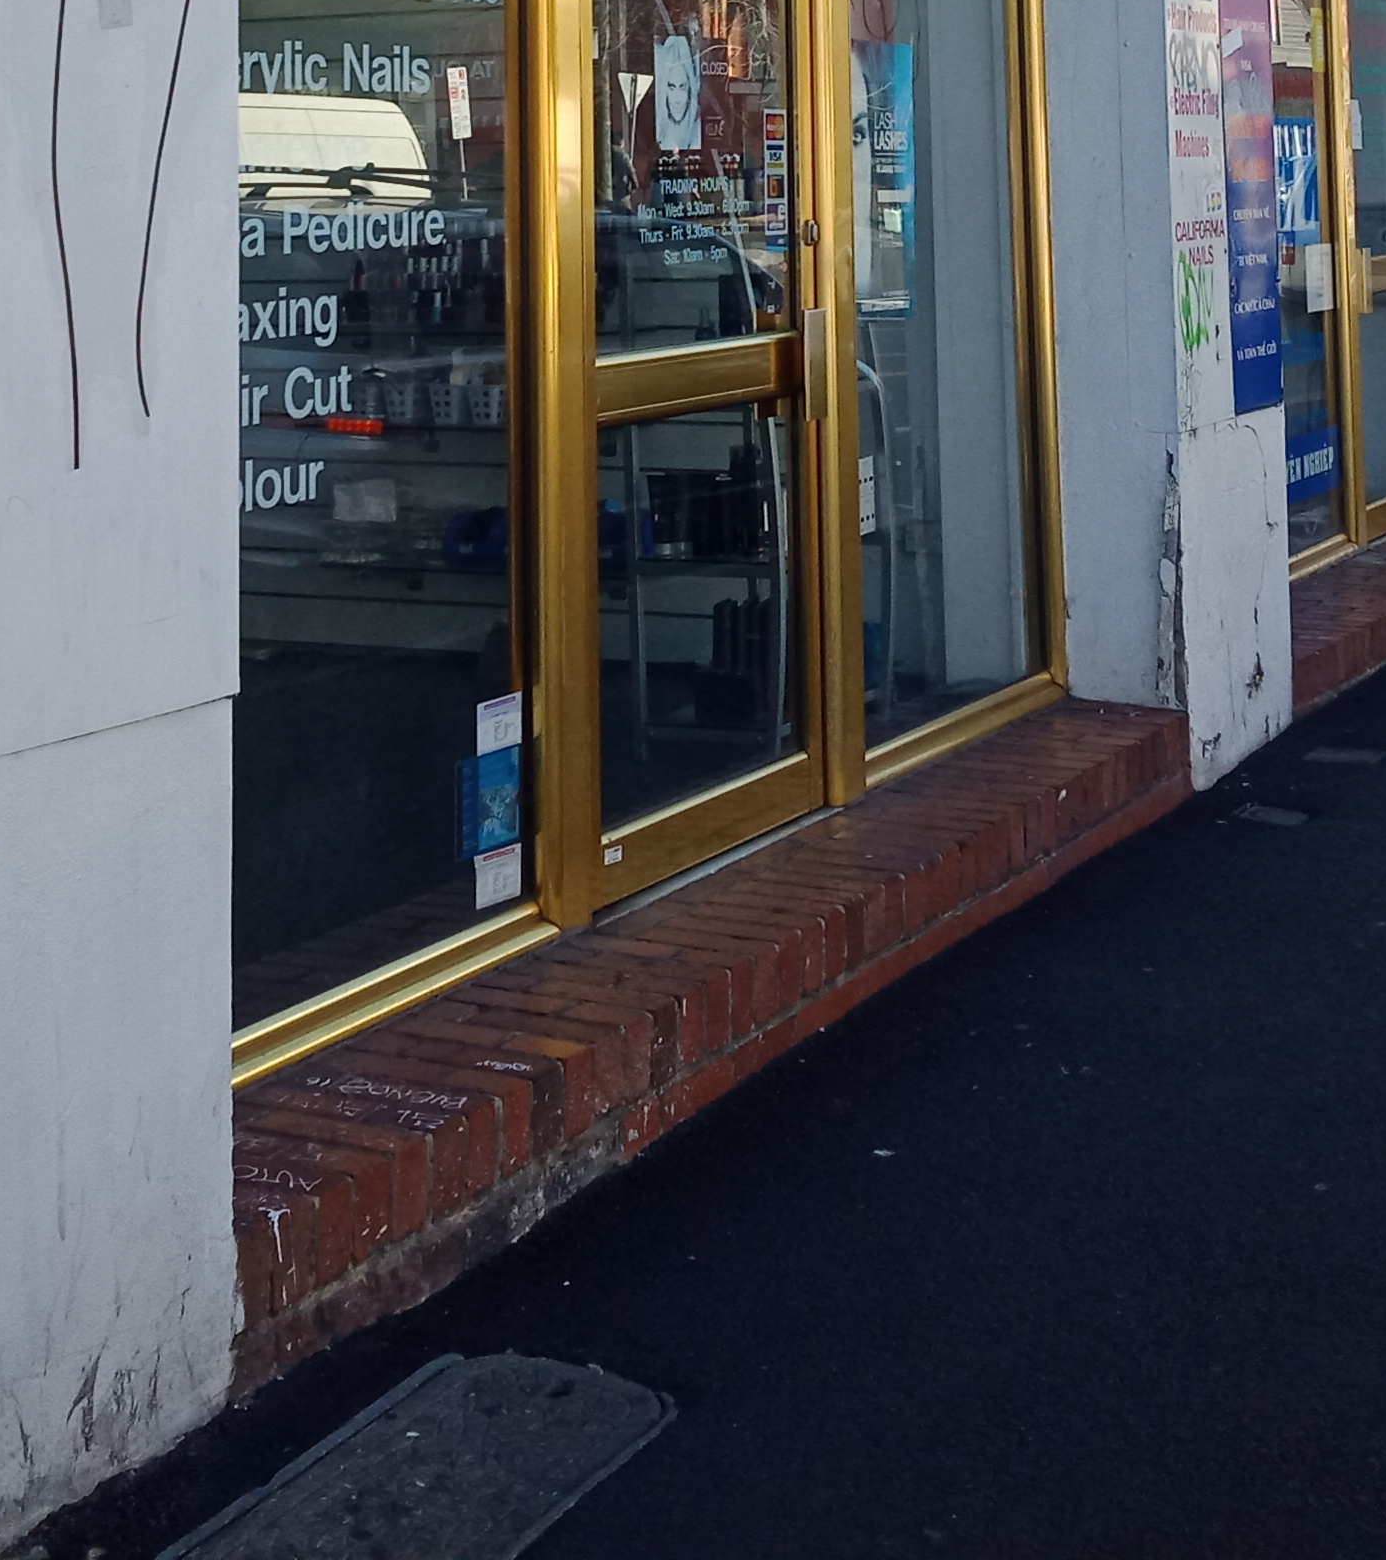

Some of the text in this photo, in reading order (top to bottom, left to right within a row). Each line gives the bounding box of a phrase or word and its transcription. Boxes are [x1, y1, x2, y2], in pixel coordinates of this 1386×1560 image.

[237, 40, 432, 95] rylic Nails
[874, 131, 908, 151] LASHES
[660, 177, 730, 195] TRADING HOURS
[637, 204, 656, 220] Mon
[664, 202, 684, 218] Wed:
[686, 200, 714, 216] 9.30am
[241, 201, 445, 258] a Pedicure
[639, 228, 663, 245] Thurs
[671, 226, 684, 241] Fri:
[686, 224, 714, 240] 9.30am
[1175, 219, 1225, 242] CALIFORNIA
[683, 248, 703, 263] 10am
[710, 246, 728, 262] 5pm
[1188, 244, 1214, 267] NAILS
[240, 365, 352, 428] ir Cut
